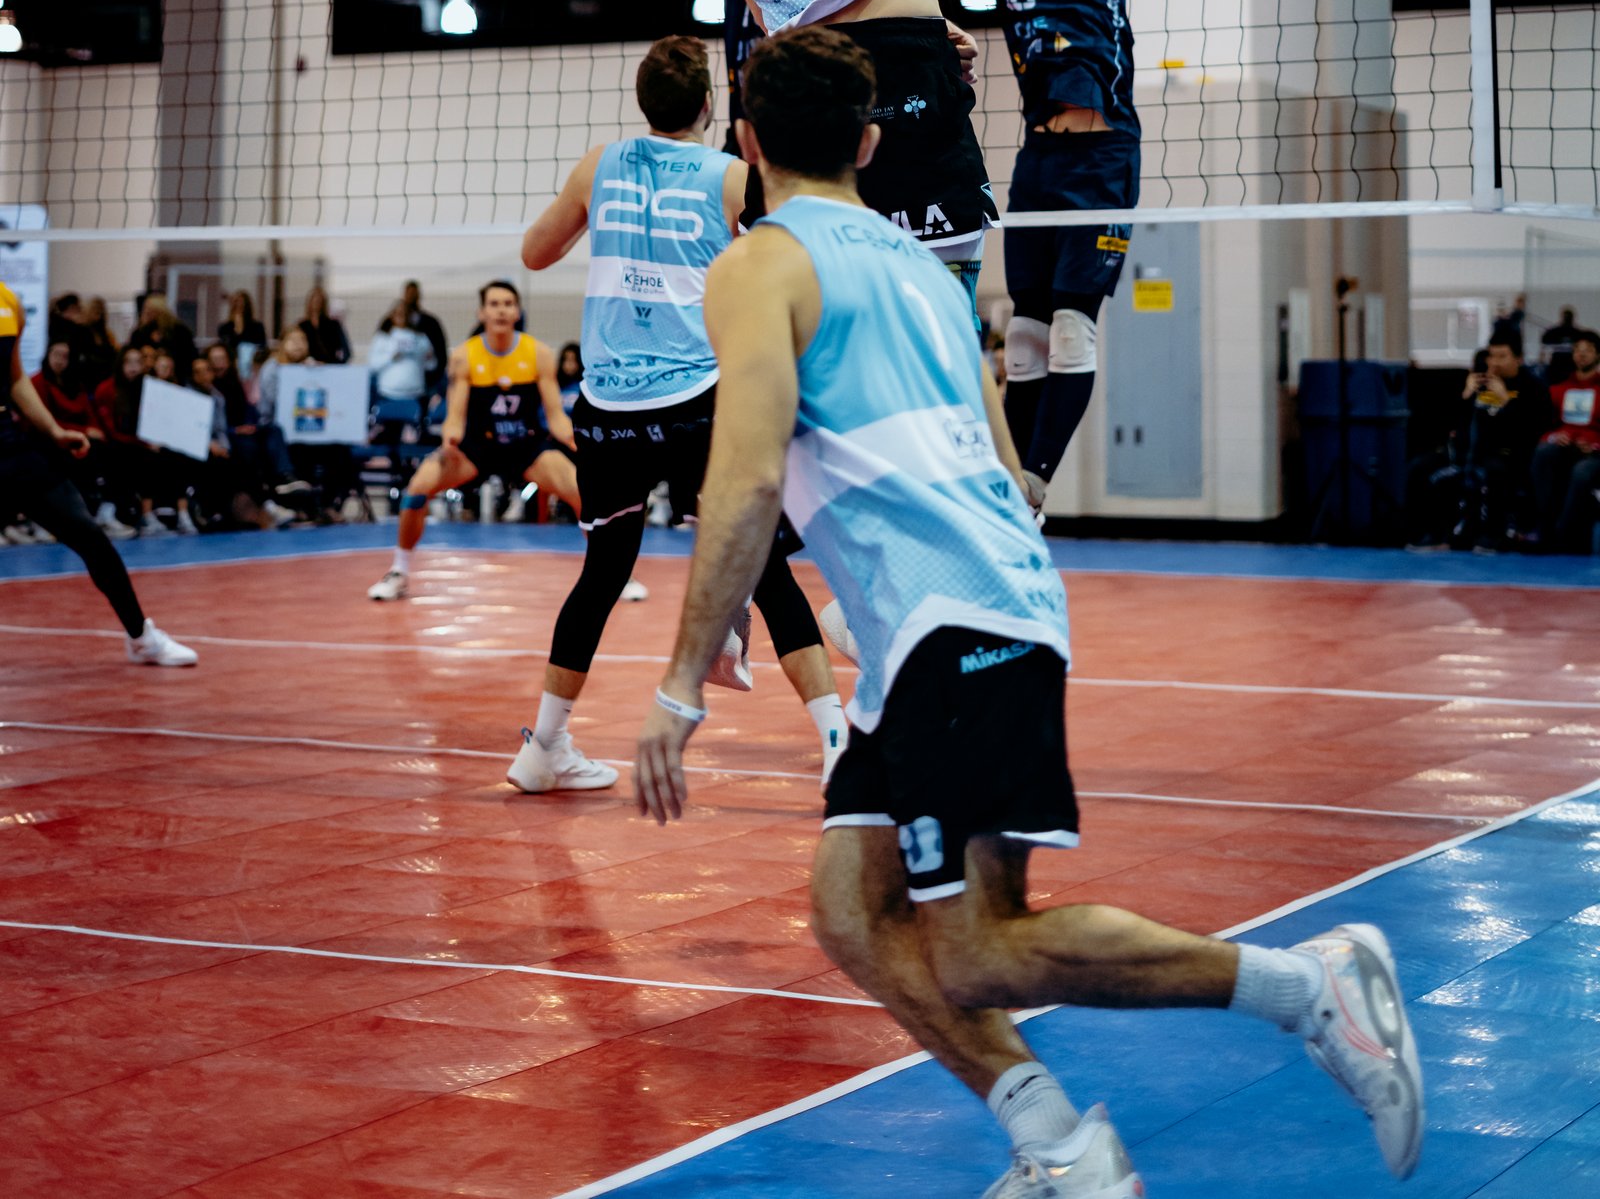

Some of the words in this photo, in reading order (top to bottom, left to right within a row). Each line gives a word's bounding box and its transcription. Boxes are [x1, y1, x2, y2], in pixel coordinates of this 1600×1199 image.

[596, 179, 707, 241] 25
[625, 273, 664, 288] KEHOE
[490, 394, 521, 416] 47
